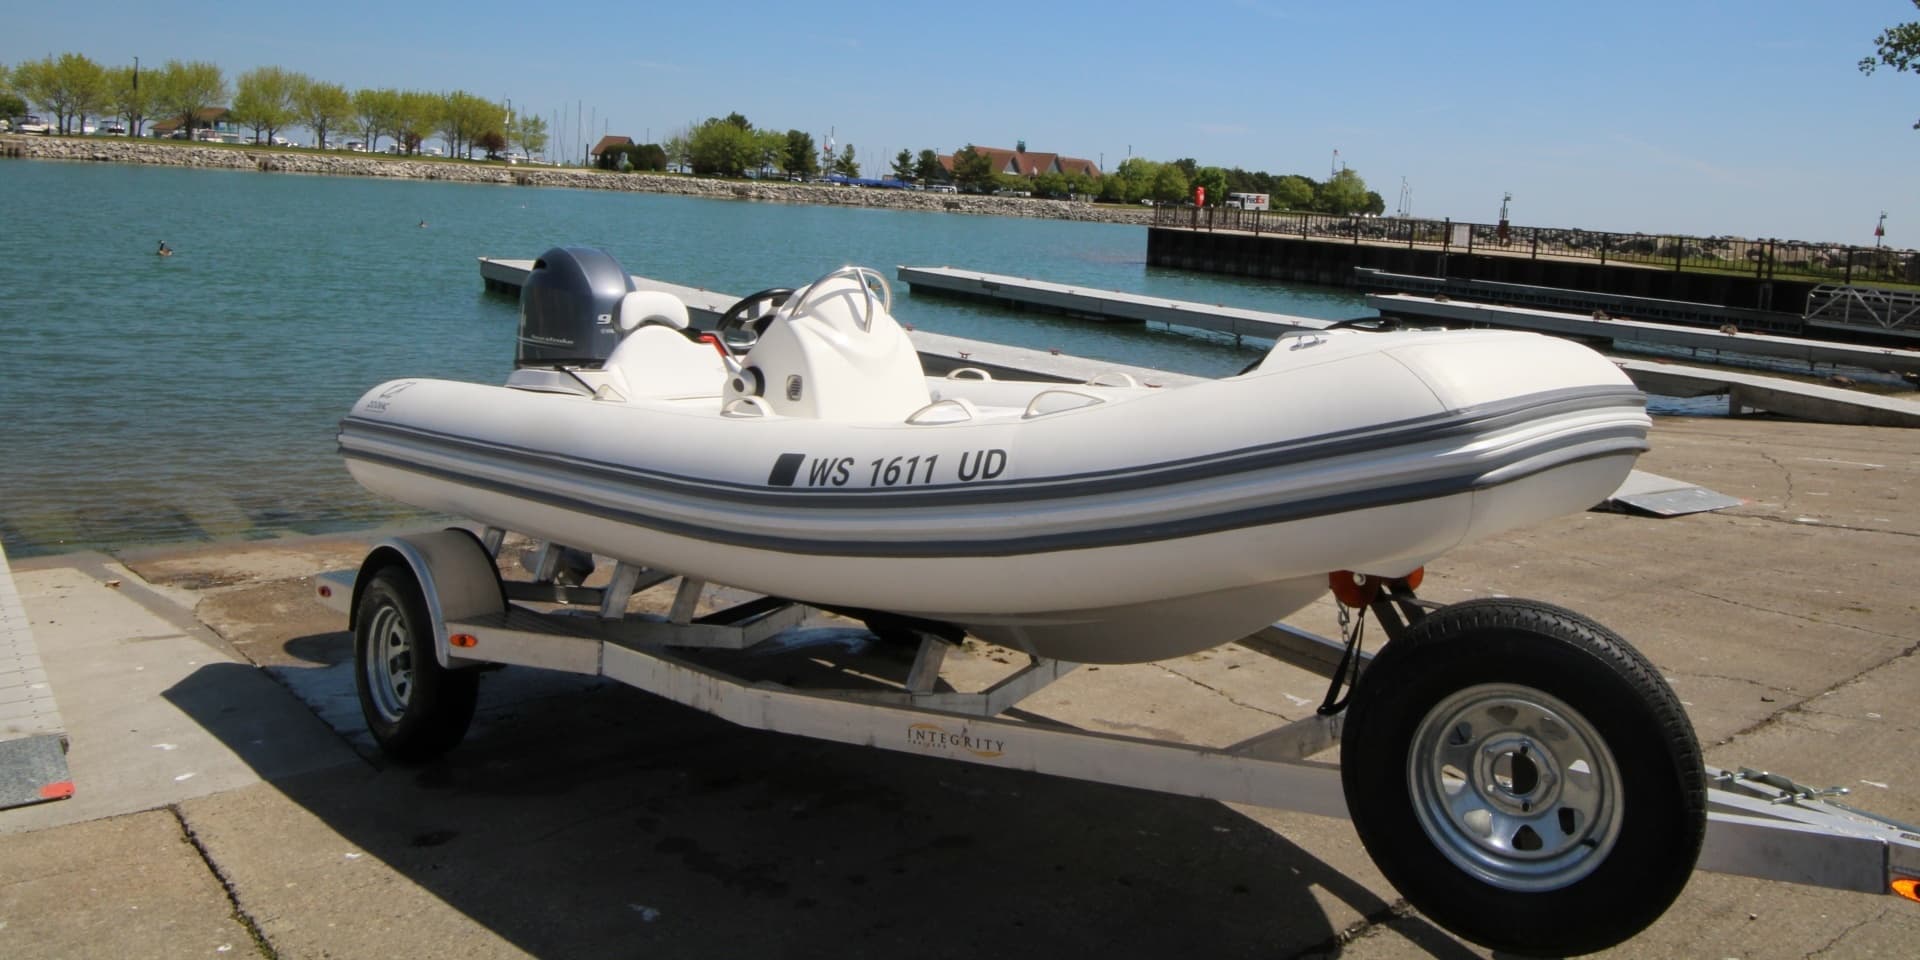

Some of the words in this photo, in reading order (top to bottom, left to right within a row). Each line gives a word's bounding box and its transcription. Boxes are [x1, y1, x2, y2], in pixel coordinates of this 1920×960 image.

[808, 457, 854, 487] WS
[870, 454, 938, 487] 1611
[957, 448, 1007, 482] UD
[907, 727, 1004, 752] INTEGRITY
